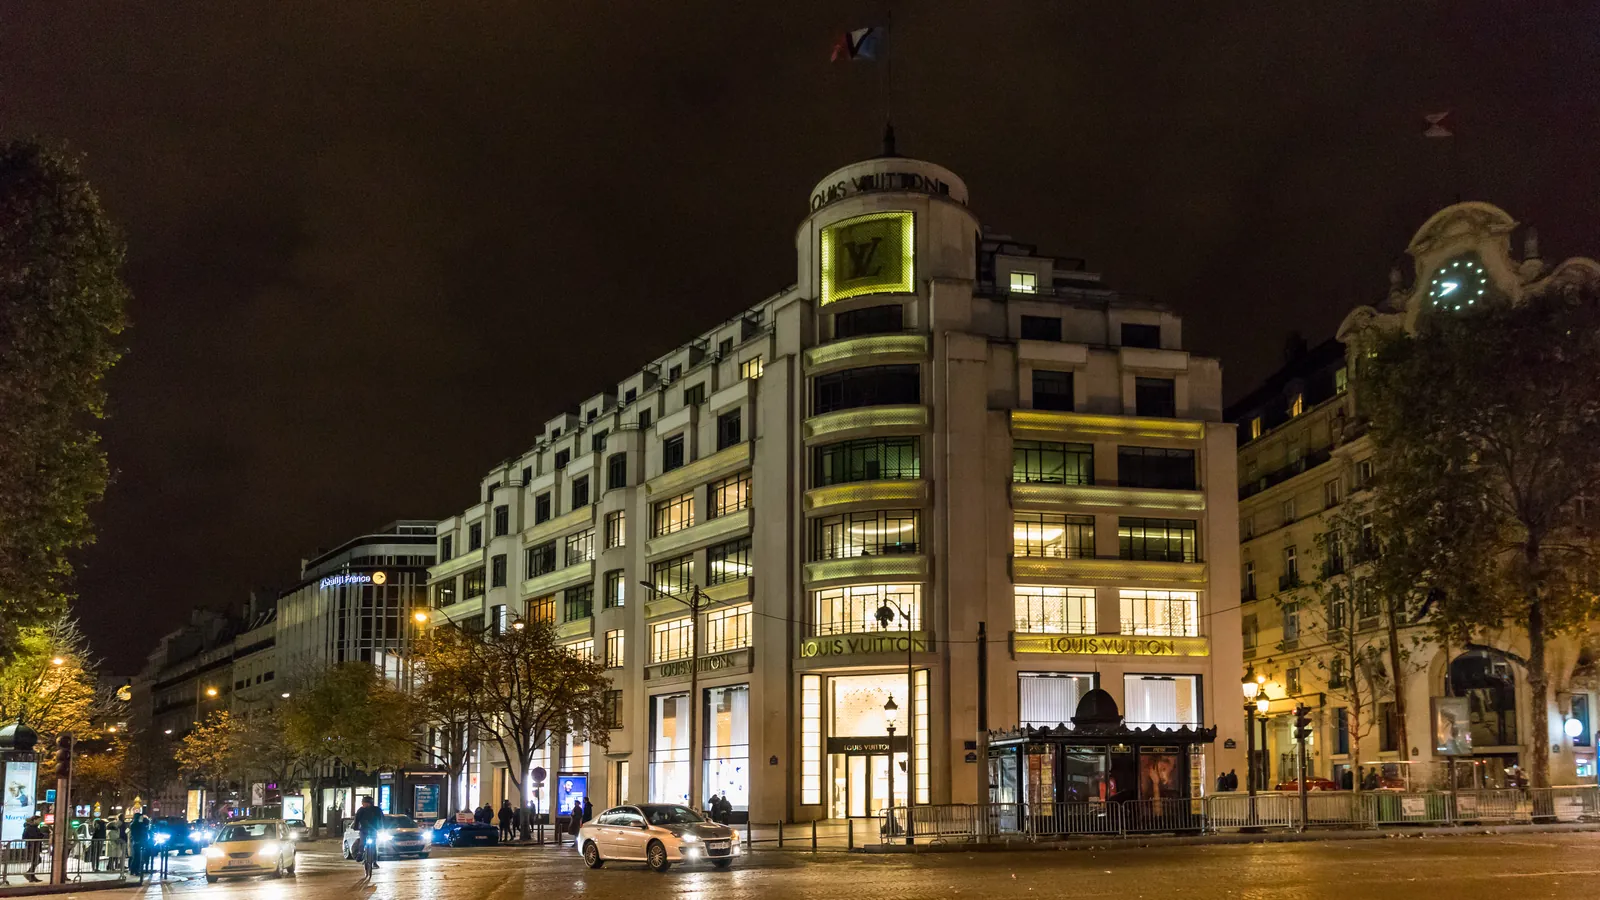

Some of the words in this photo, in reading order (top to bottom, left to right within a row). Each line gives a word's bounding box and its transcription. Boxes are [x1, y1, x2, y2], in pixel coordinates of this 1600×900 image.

[812, 181, 847, 211] OUIS
[345, 575, 371, 583] France
[801, 639, 843, 657] LOUIS
[847, 637, 926, 654] VUITTON
[1050, 637, 1098, 653] LOUIS
[1101, 638, 1174, 654] VUITTON
[660, 661, 685, 677] LOUIS
